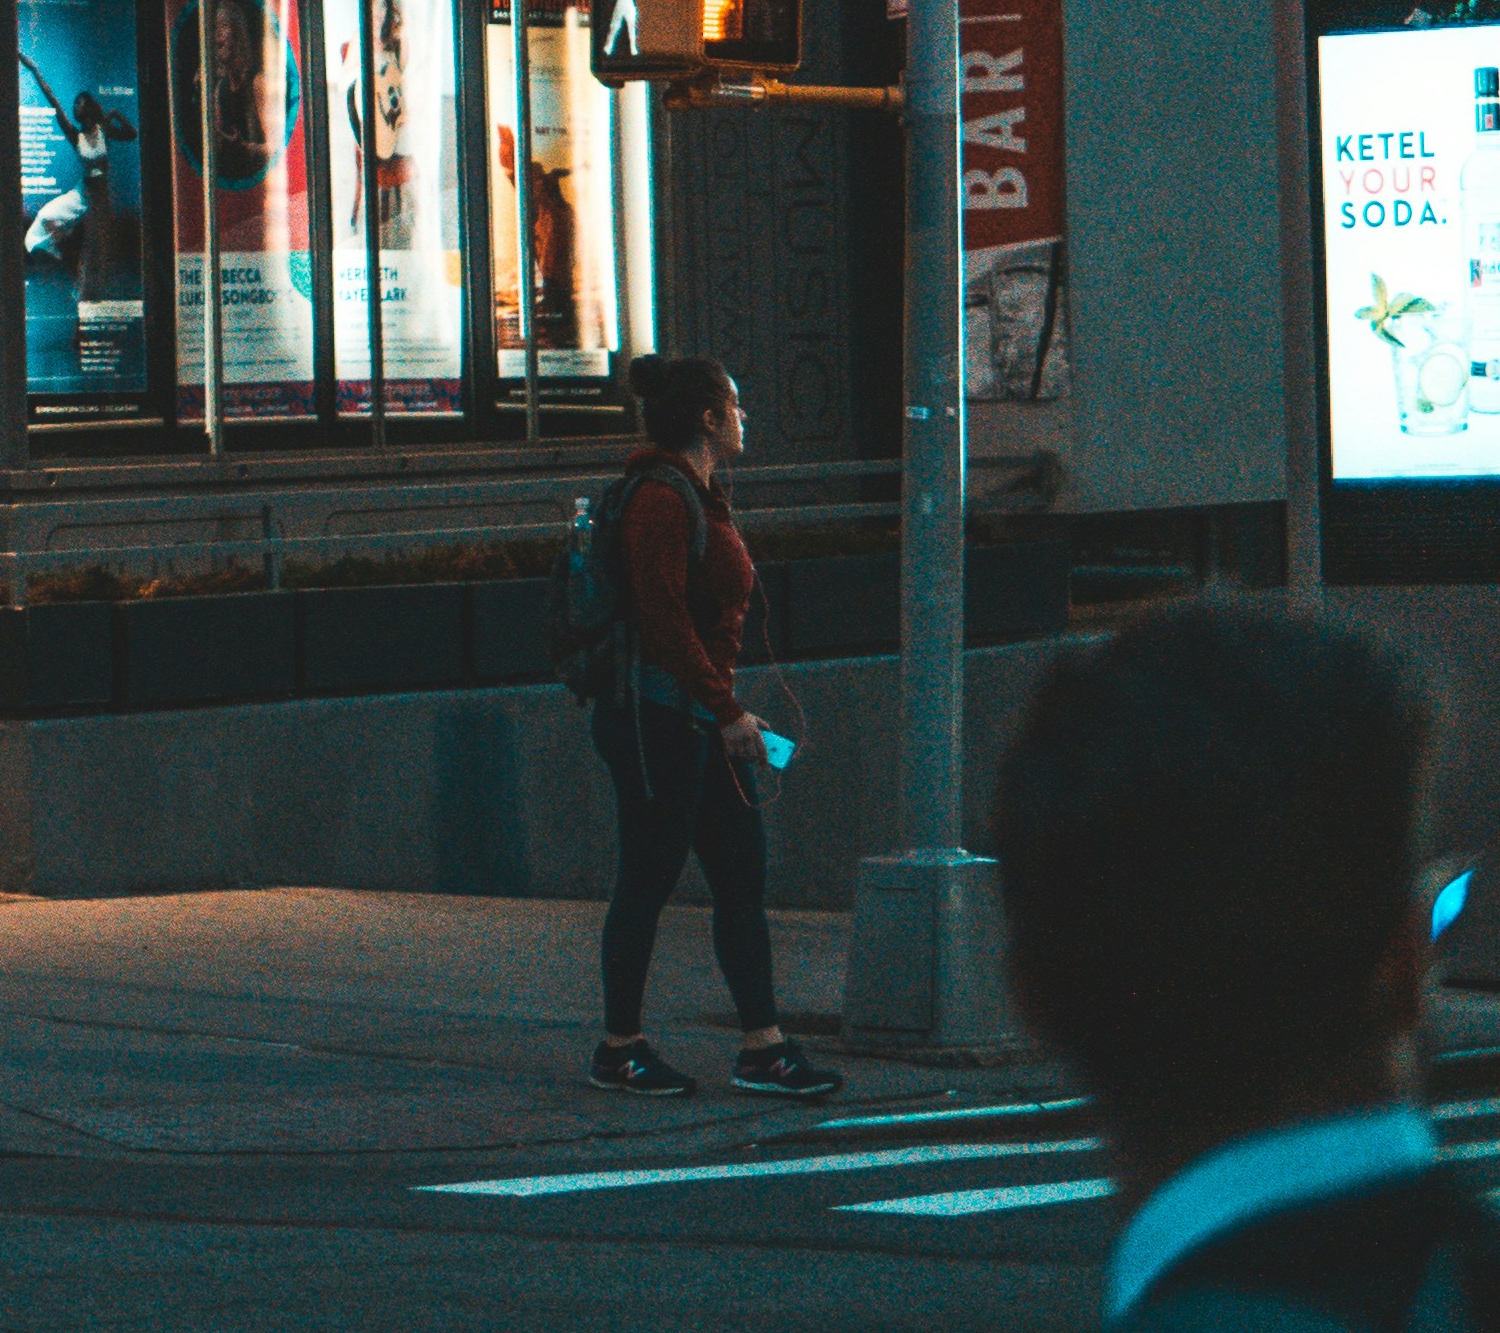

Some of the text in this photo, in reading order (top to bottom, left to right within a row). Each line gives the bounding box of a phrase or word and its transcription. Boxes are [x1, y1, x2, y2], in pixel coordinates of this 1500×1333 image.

[1335, 131, 1437, 163] KETEL
[1338, 165, 1438, 196] YOUR
[1339, 198, 1449, 231] SODA.
[178, 267, 262, 285] THE BECCA
